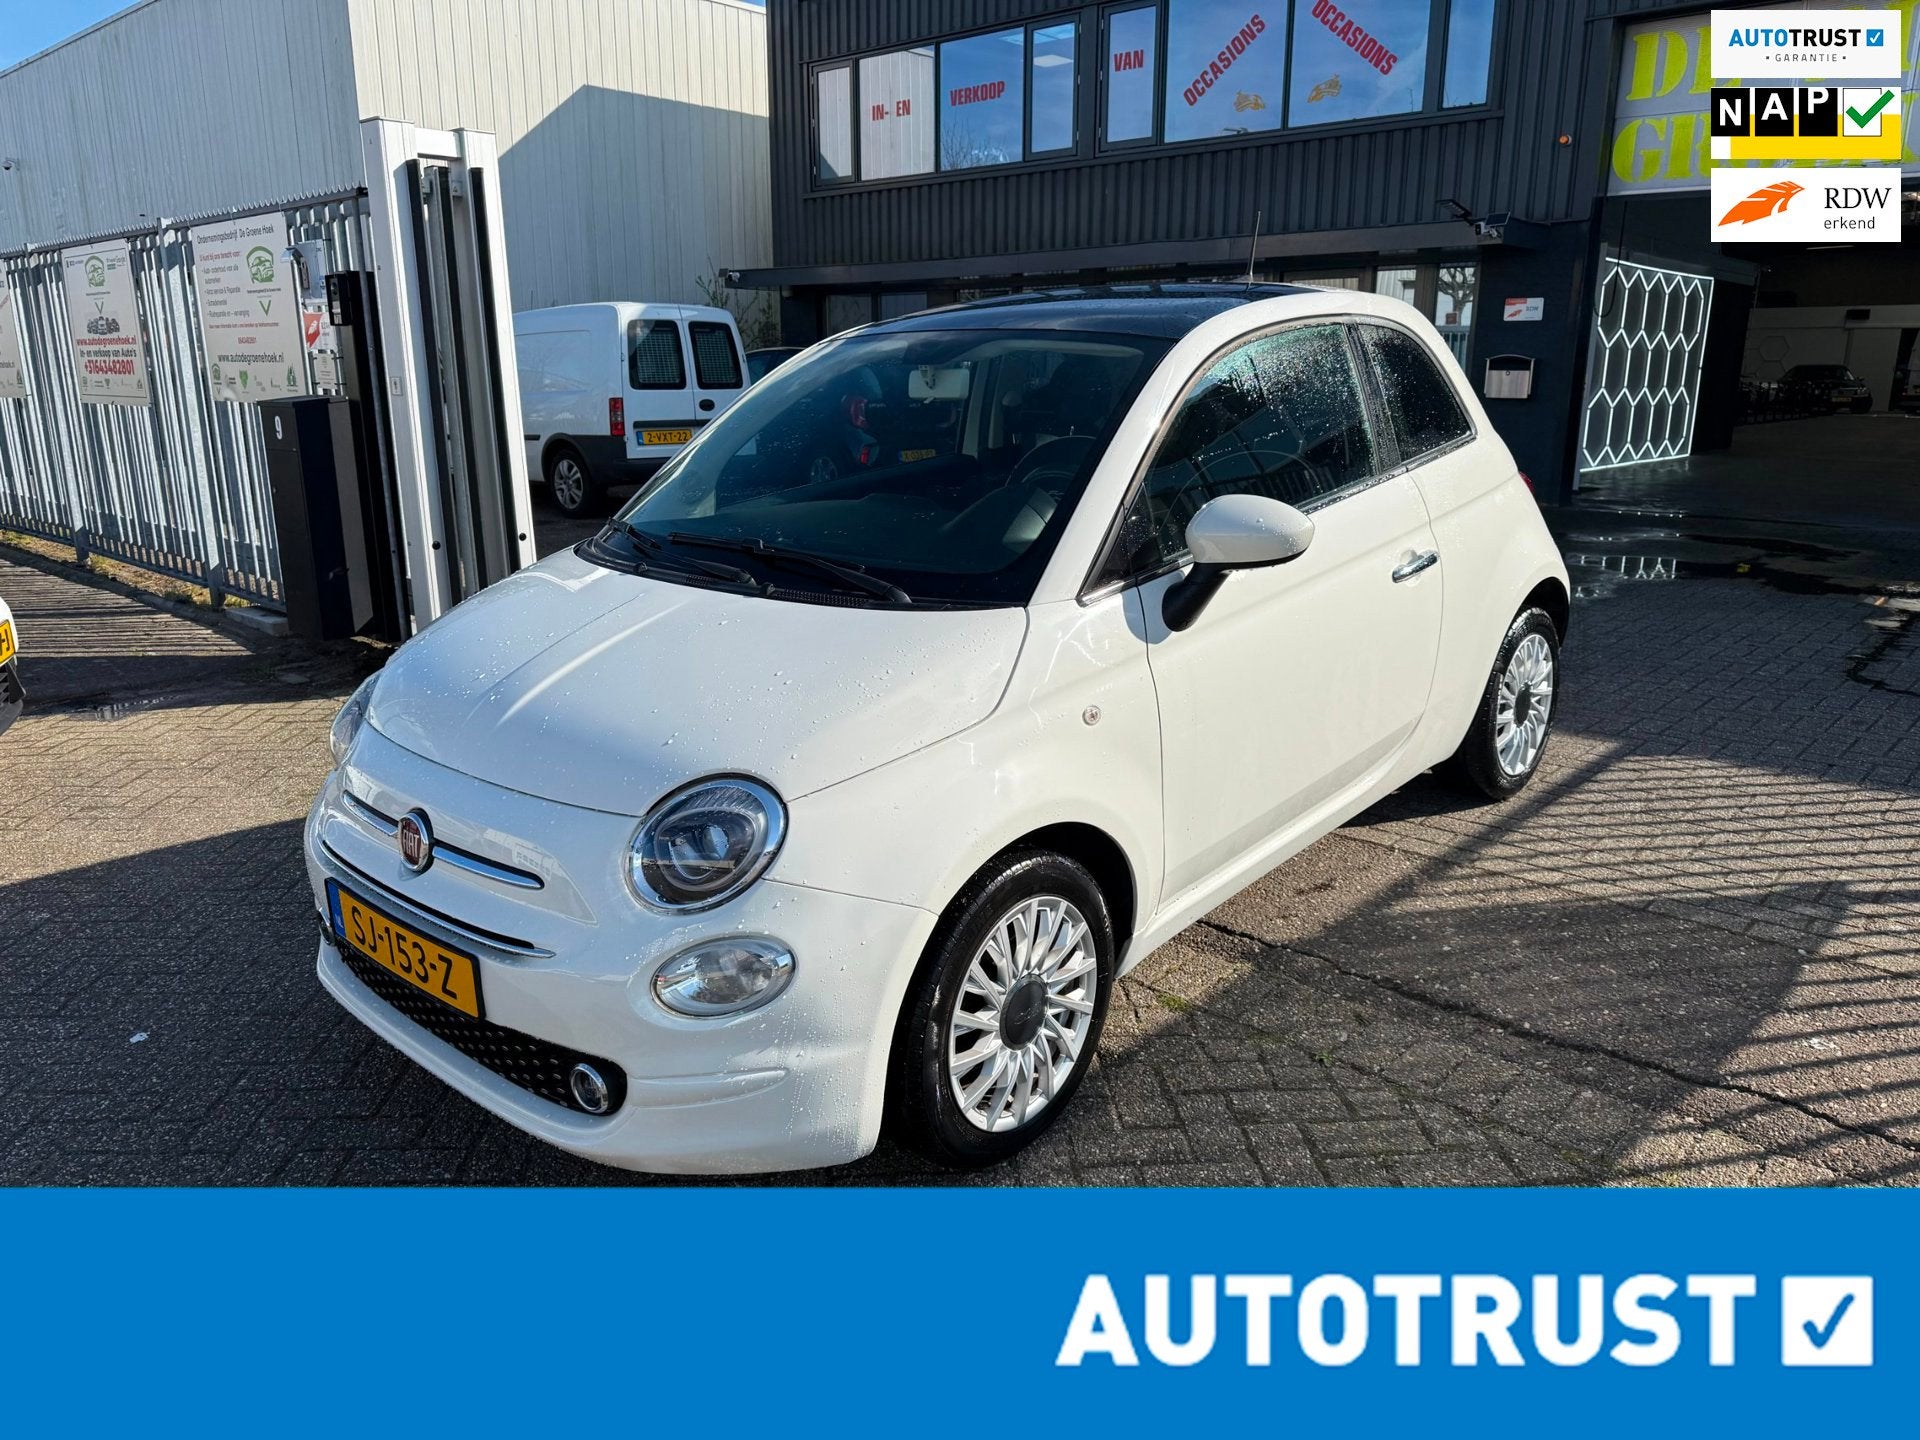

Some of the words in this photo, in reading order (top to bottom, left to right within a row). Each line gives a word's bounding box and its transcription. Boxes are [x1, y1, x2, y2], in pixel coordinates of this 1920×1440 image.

[1312, 0, 1398, 76] OCCASIONS
[1183, 13, 1266, 107] OCCASIONS
[872, 104, 889, 121] IN-
[896, 99, 911, 117] EN
[950, 80, 1005, 107] VERKOOP
[1113, 49, 1144, 72] VAN
[246, 227, 262, 238] Groene
[262, 224, 274, 234] Hoek
[76, 334, 137, 348] www.autodegroenehoek.nl
[86, 350, 92, 358] en
[92, 348, 111, 360] verkoop
[111, 350, 120, 358] van
[121, 348, 137, 358] Auto's
[217, 352, 285, 366] www.autodegroenehoek.nl
[274, 415, 283, 440] 9
[647, 431, 688, 443] 2-VXT-22
[402, 830, 420, 859] FIAT
[351, 905, 458, 1000] SJ-153-Z
